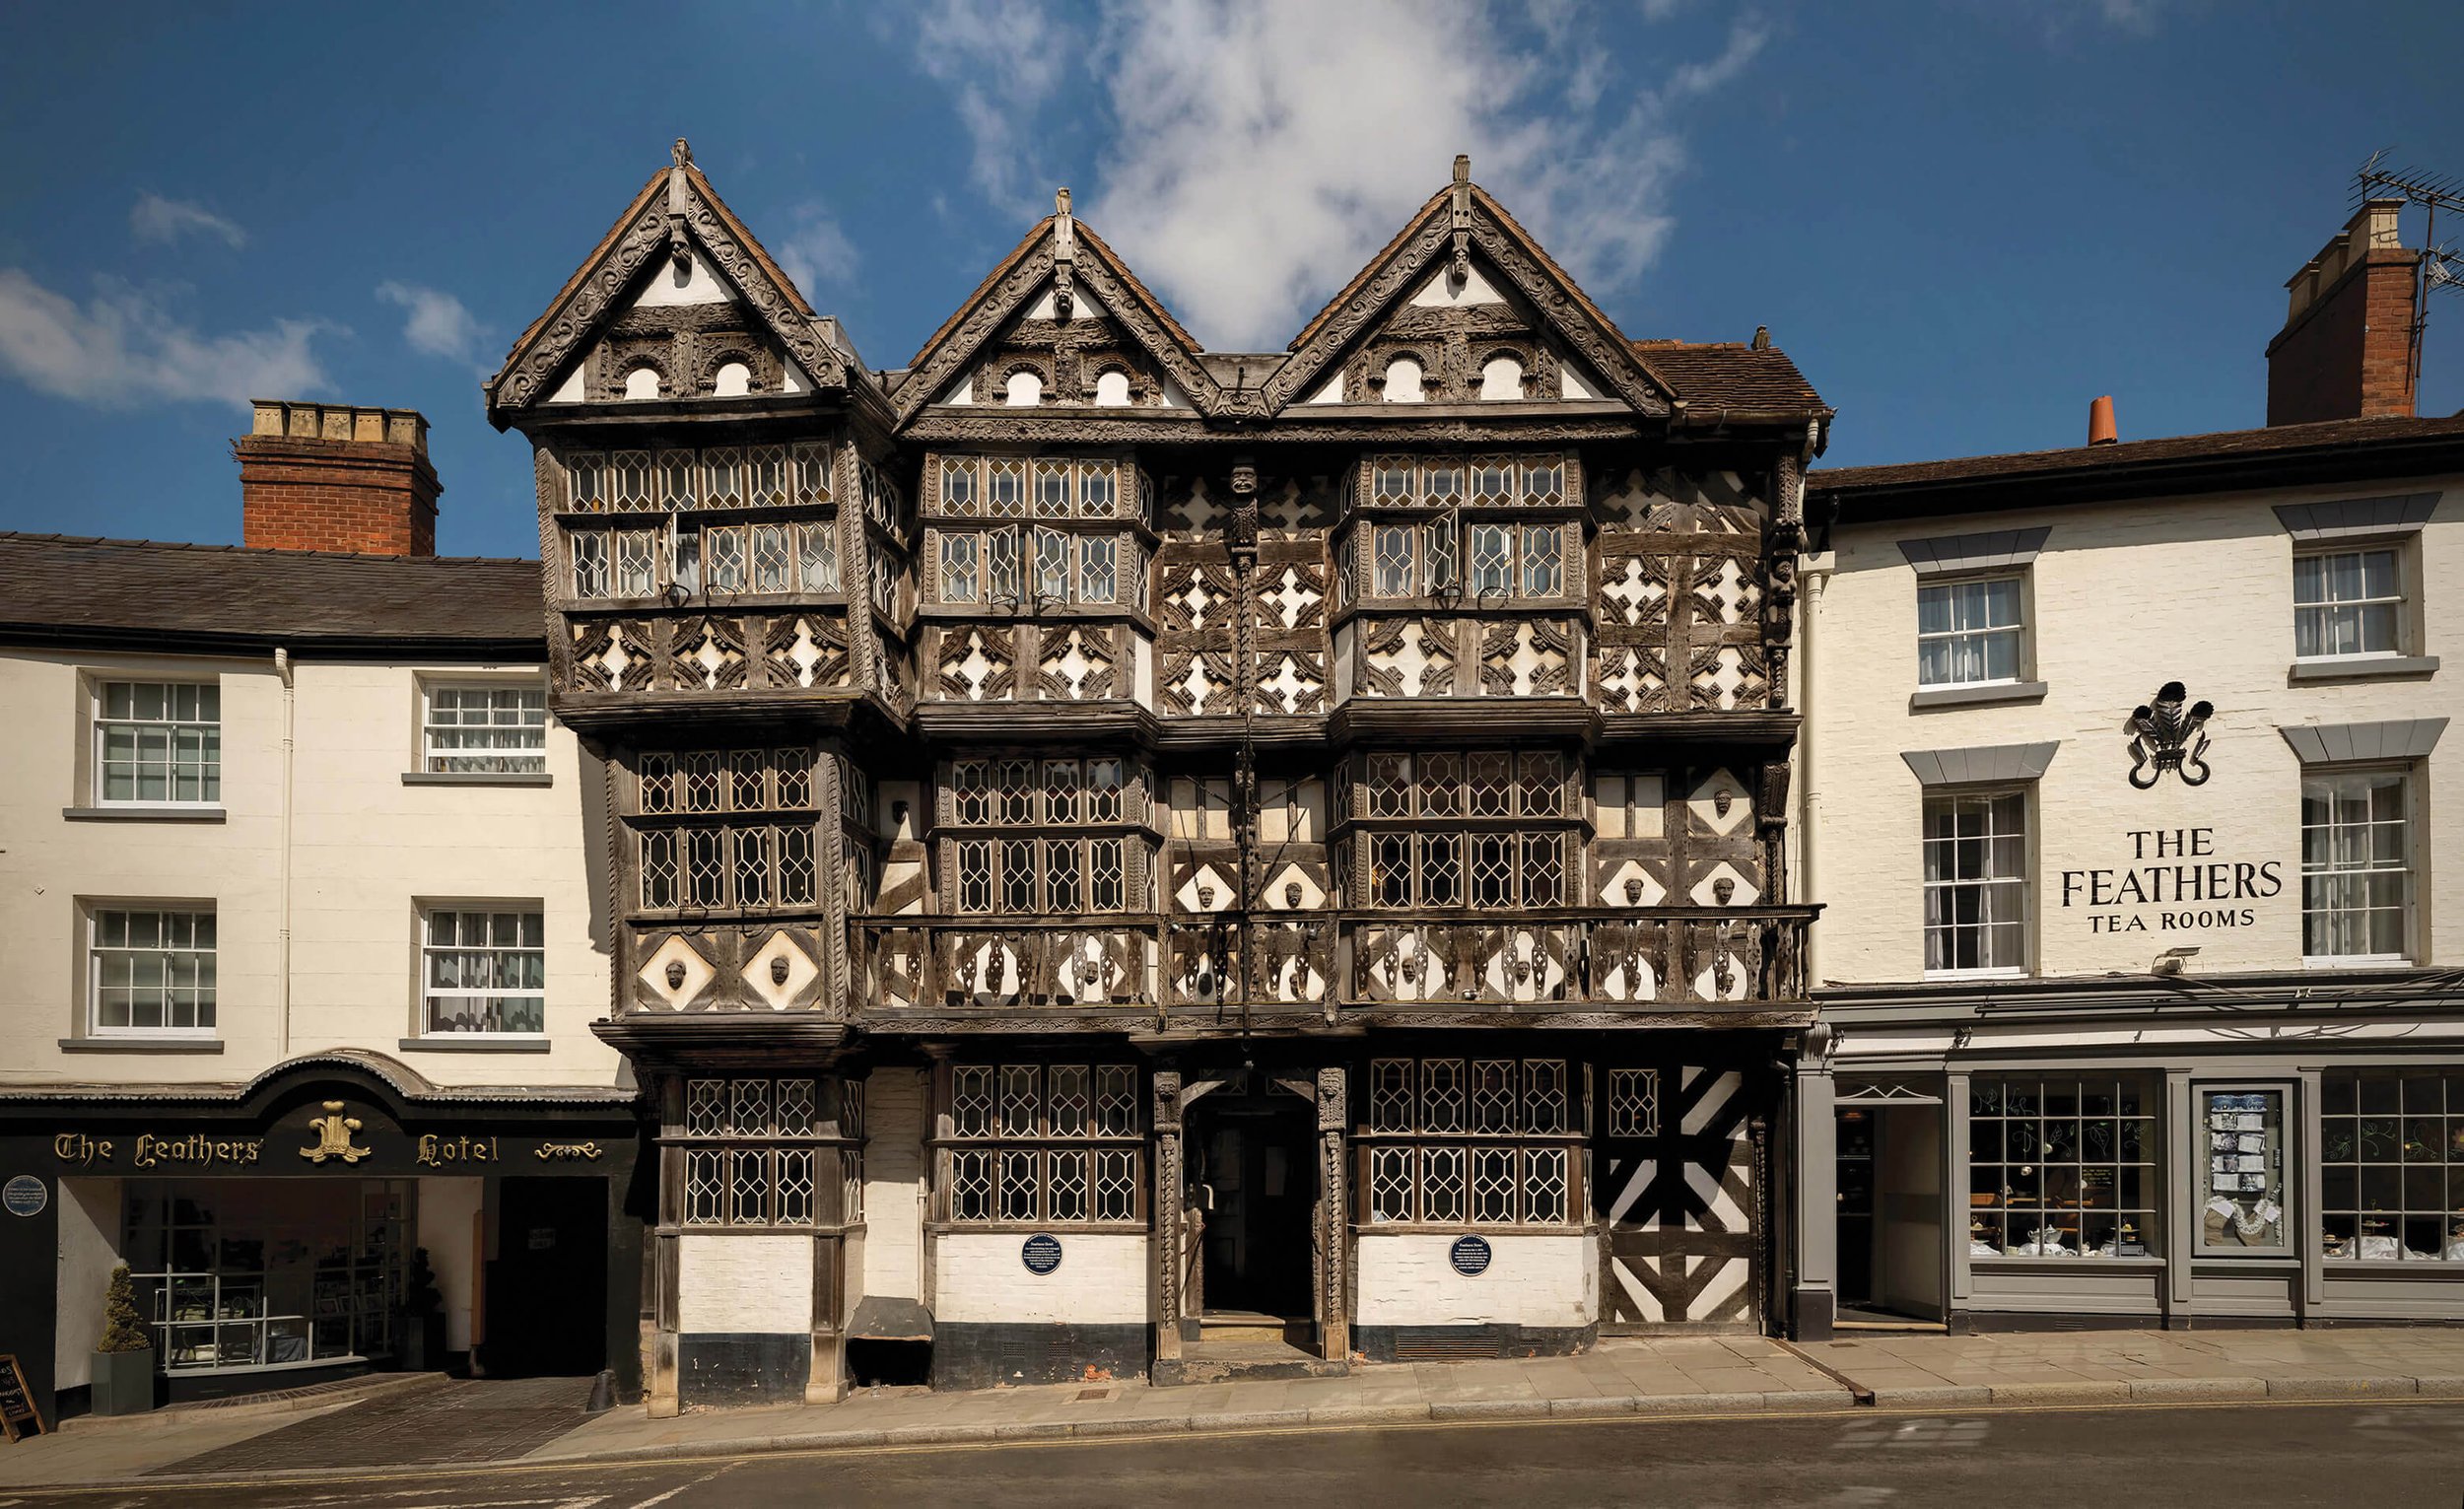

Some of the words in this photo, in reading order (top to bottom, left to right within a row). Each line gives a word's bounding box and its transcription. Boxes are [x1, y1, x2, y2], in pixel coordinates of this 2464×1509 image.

[2127, 828, 2215, 859] THE
[2061, 860, 2283, 908] FEATHERS
[2087, 914, 2148, 934] TEA
[2160, 909, 2255, 930] ROOMS
[54, 1132, 113, 1167] The
[134, 1132, 265, 1168] Feathers
[415, 1132, 499, 1168] Hotel
